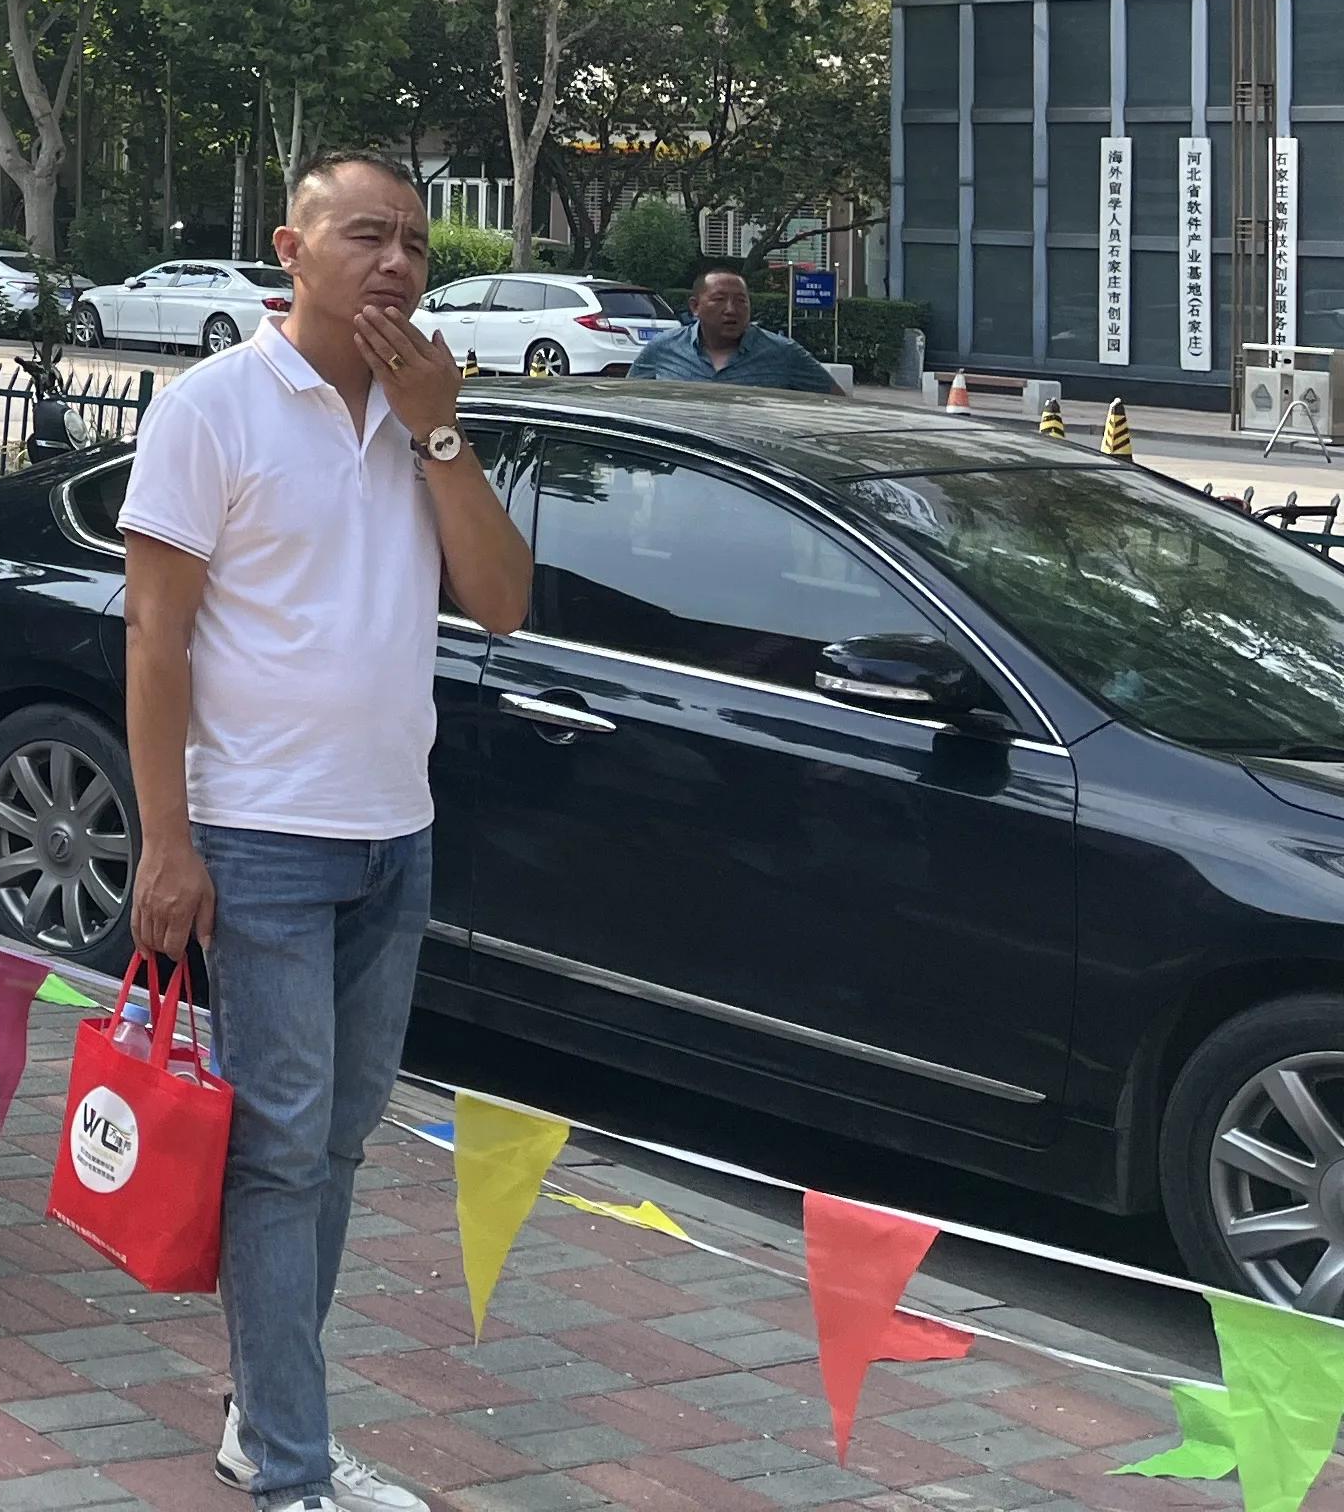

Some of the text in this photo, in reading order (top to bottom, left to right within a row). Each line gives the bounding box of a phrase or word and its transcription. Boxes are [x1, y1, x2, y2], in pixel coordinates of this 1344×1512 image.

[1107, 150, 1123, 352] 海外留学人员石家庄市创业园
[1186, 151, 1203, 356] 河北省软件产业基地(石家庄)
[1275, 152, 1289, 364] 石家庄高新技术创业服务中
